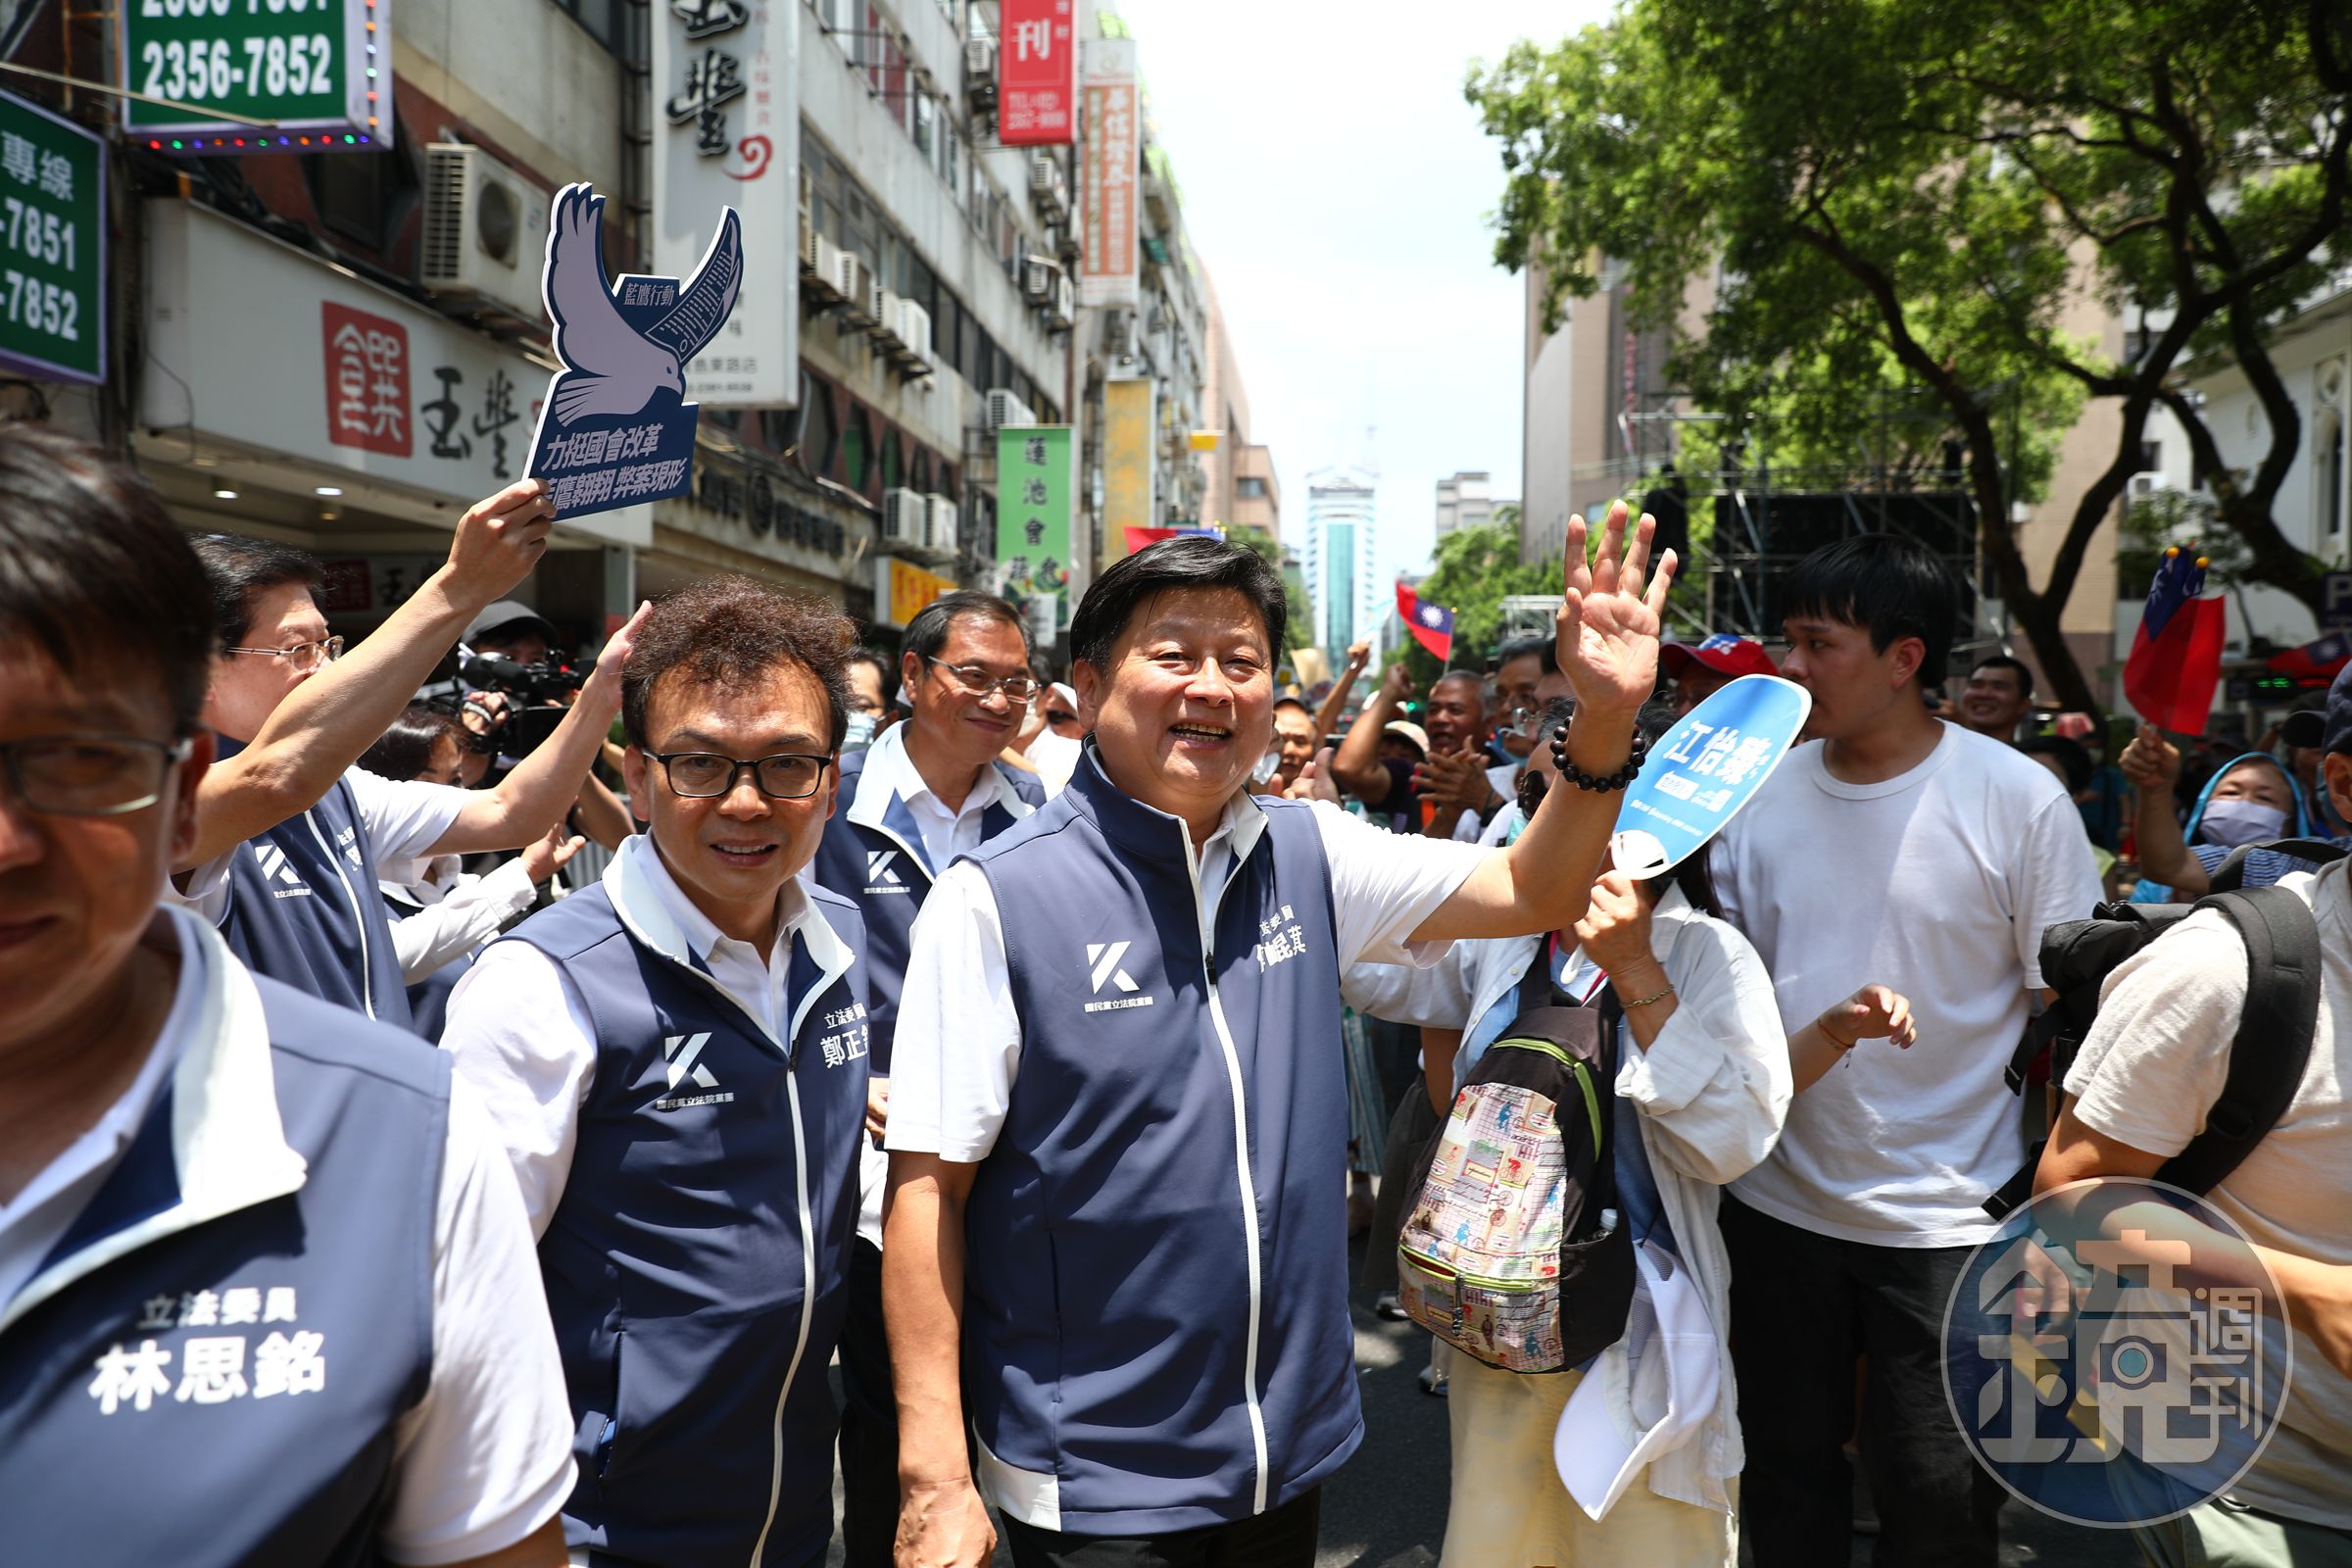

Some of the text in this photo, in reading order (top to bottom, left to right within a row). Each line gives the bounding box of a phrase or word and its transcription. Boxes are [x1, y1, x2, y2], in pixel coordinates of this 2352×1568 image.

[1011, 18, 1051, 62] 刊
[142, 33, 332, 100] 2356-7852
[1, 129, 74, 201] 專線
[623, 282, 675, 306] 藍鷹行動
[540, 422, 663, 472] 力挺國會改革
[612, 457, 688, 501] 弊案現形
[824, 1003, 867, 1029] 立法委員
[137, 1286, 297, 1330] 立法委員
[87, 1330, 325, 1416] 林思銘
